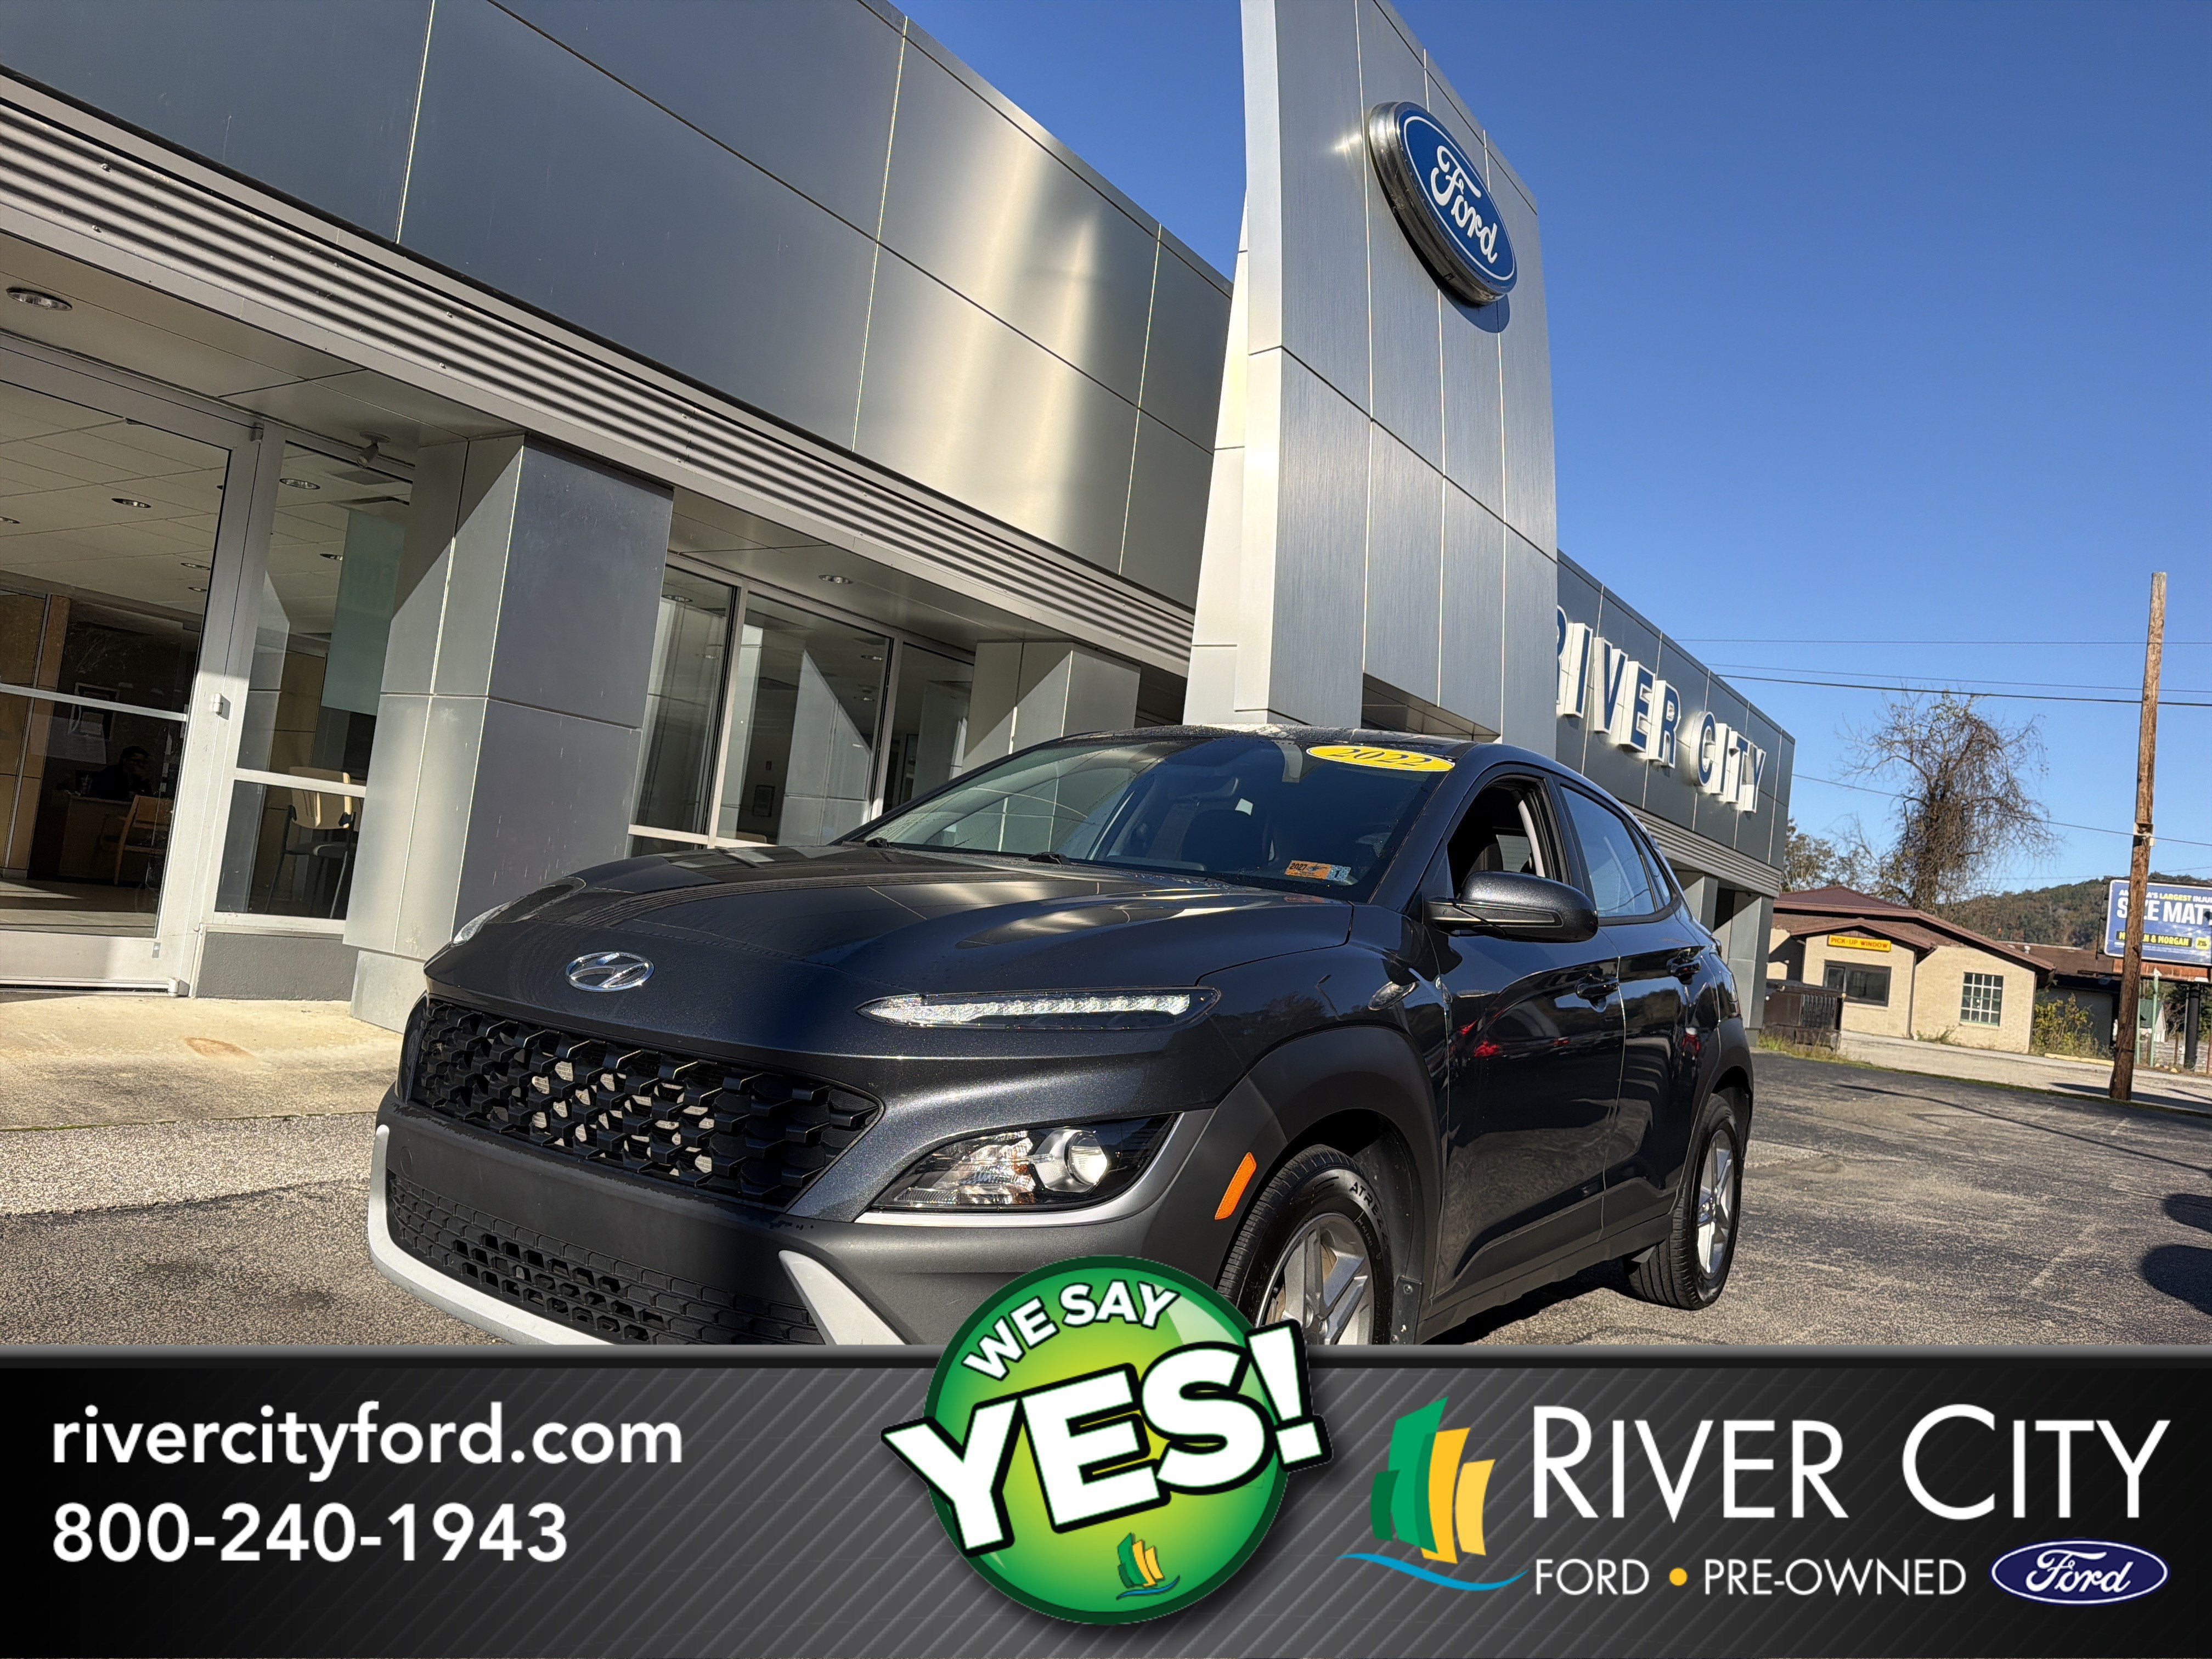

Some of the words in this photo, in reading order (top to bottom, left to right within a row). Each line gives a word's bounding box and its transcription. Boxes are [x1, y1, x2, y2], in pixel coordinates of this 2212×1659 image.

[1430, 145, 1498, 264] Ford
[1325, 748, 1432, 766] 2022
[1690, 711, 1767, 813] CITY
[1289, 862, 1308, 871] 2027
[2119, 889, 2158, 900] AMA'S
[2159, 893, 2192, 901] LARGEST
[2192, 895, 2212, 904] INJU
[2117, 897, 2160, 921] SE
[1860, 940, 1888, 949] WINDOW
[2158, 935, 2190, 946] MORGAN
